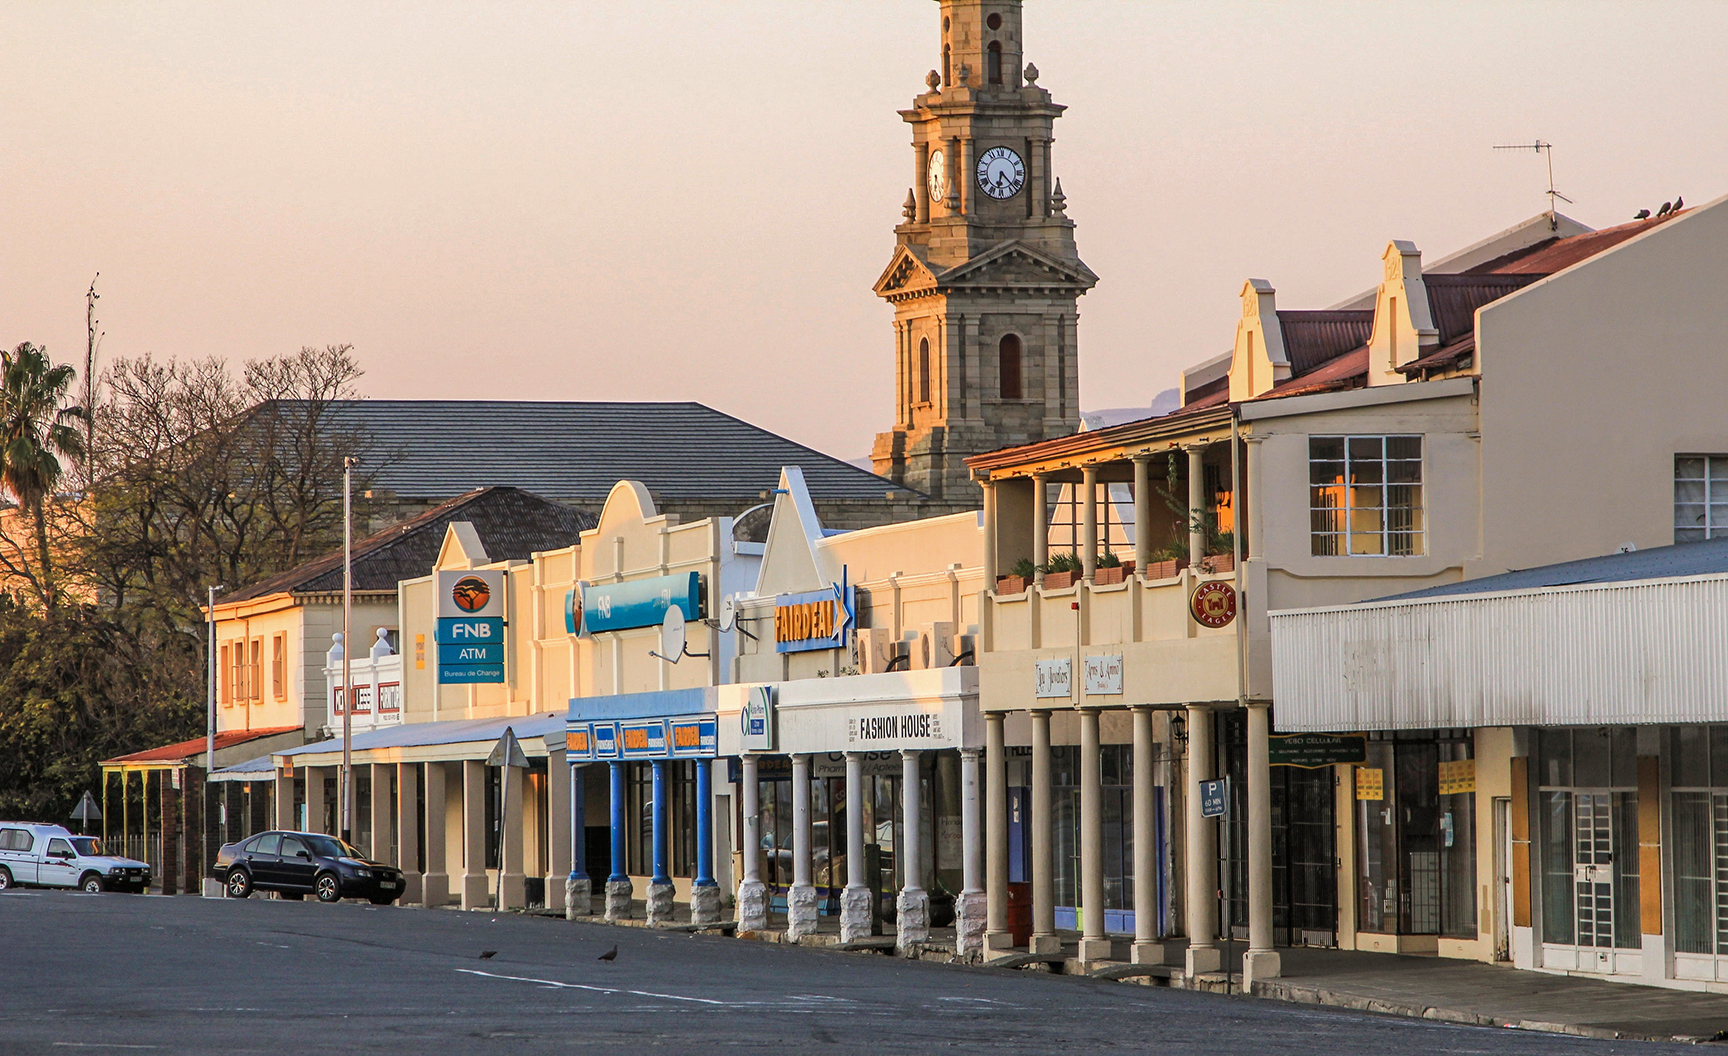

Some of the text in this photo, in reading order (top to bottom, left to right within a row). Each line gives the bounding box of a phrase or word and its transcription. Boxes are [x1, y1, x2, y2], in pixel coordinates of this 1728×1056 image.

[1198, 584, 1232, 600] CASTLE
[774, 600, 834, 643] FAIRDEAL
[1202, 610, 1233, 625] LAGER
[452, 623, 491, 638] FNB
[459, 648, 486, 659] ATM
[476, 669, 500, 677] Change
[860, 715, 898, 740] FASHION
[901, 713, 930, 738] HOUSE
[1208, 782, 1217, 796] P
[1204, 798, 1222, 807] 60 MIN
